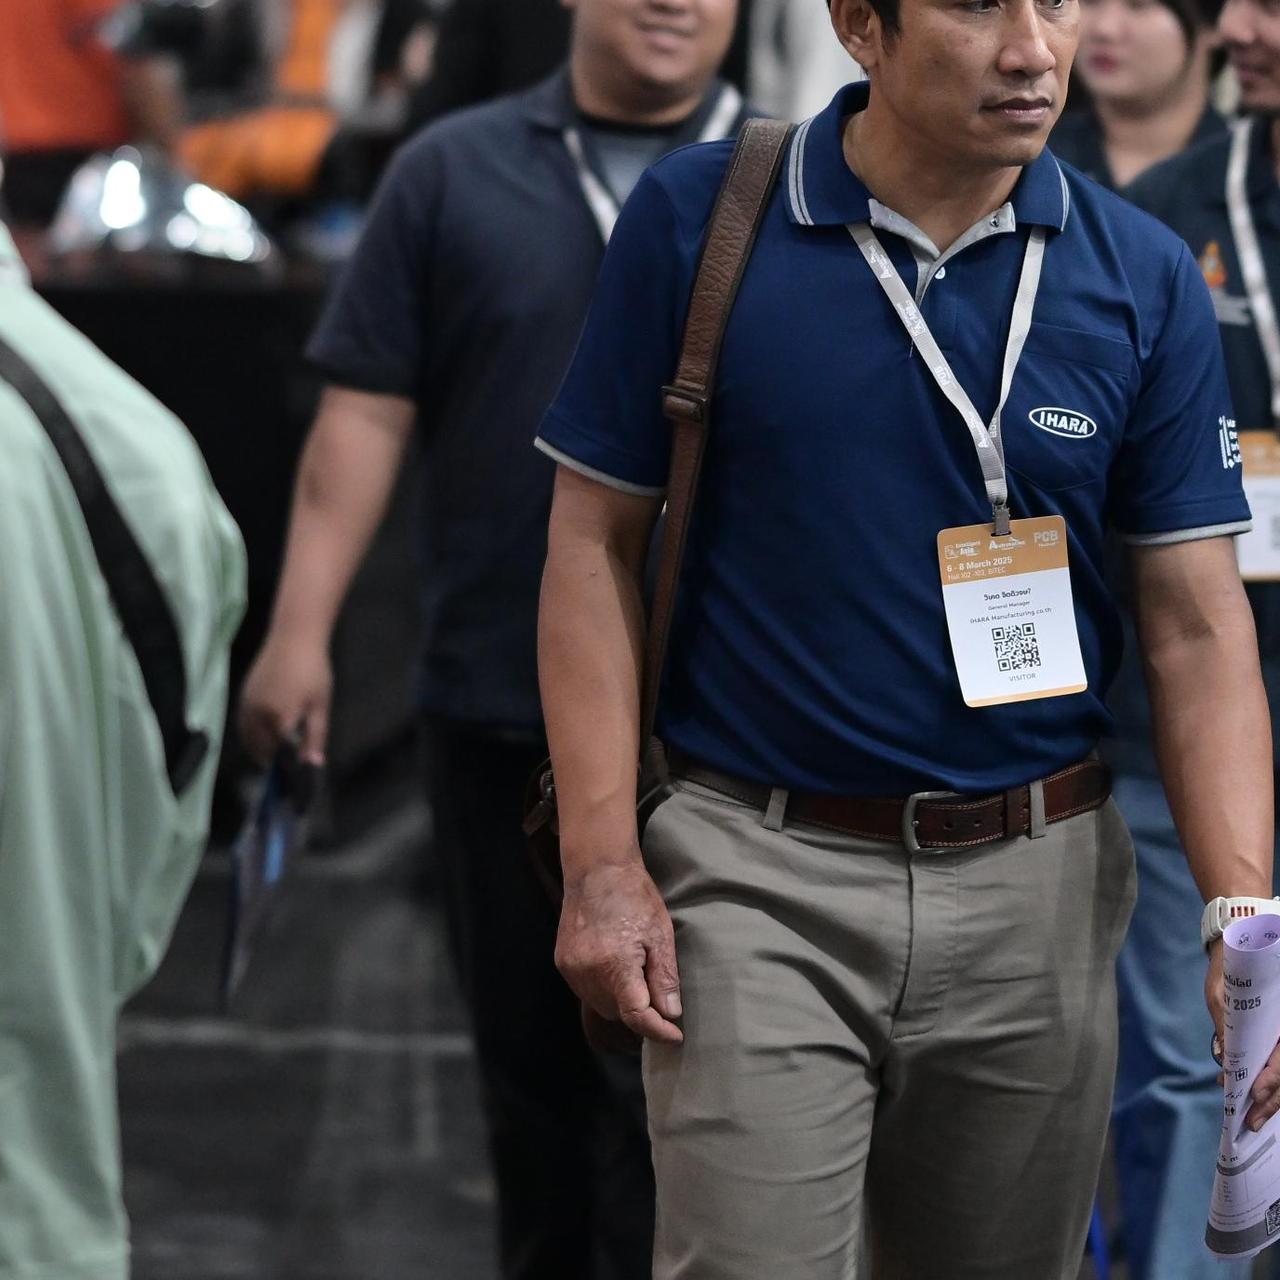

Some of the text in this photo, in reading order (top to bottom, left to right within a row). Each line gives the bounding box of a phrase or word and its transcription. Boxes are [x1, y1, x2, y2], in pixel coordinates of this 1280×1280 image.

[1039, 410, 1089, 435] IHARA
[966, 560, 992, 571] March
[992, 556, 1013, 566] 2025
[1009, 673, 1037, 682] VISITOR
[1233, 996, 1262, 1011] 2025
